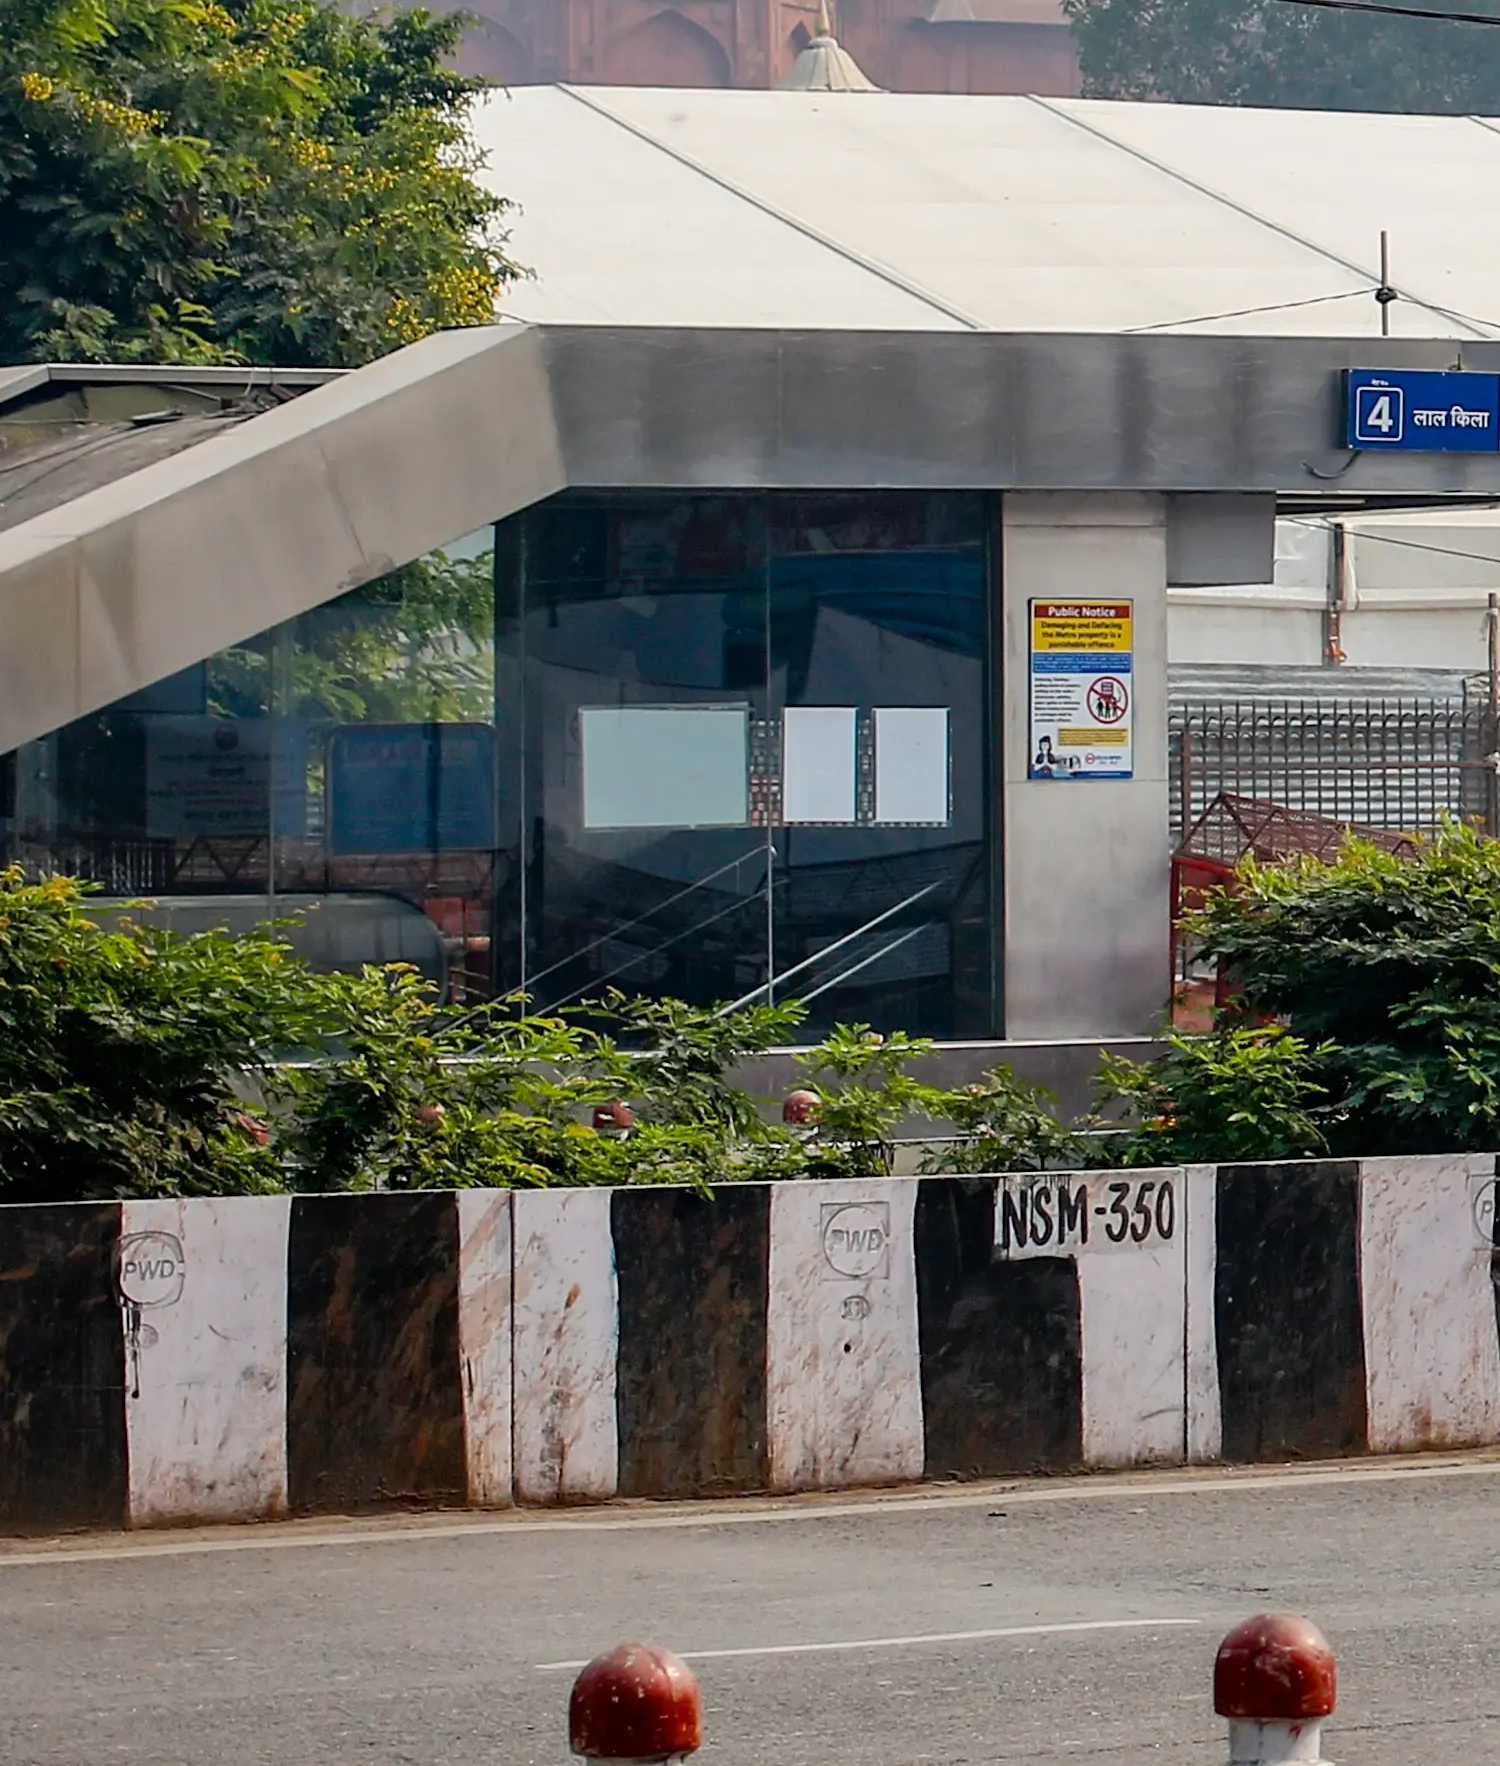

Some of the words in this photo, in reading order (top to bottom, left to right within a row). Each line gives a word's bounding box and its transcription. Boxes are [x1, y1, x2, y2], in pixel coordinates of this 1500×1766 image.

[1367, 396, 1394, 433] 4
[1413, 410, 1448, 427] लाल
[1450, 405, 1490, 428] किला
[1048, 606, 1080, 618] Public
[1082, 606, 1116, 617] Notice
[1002, 1180, 1175, 1249] NSM-350
[830, 1227, 885, 1254] PWD
[122, 1259, 175, 1283] PWD
